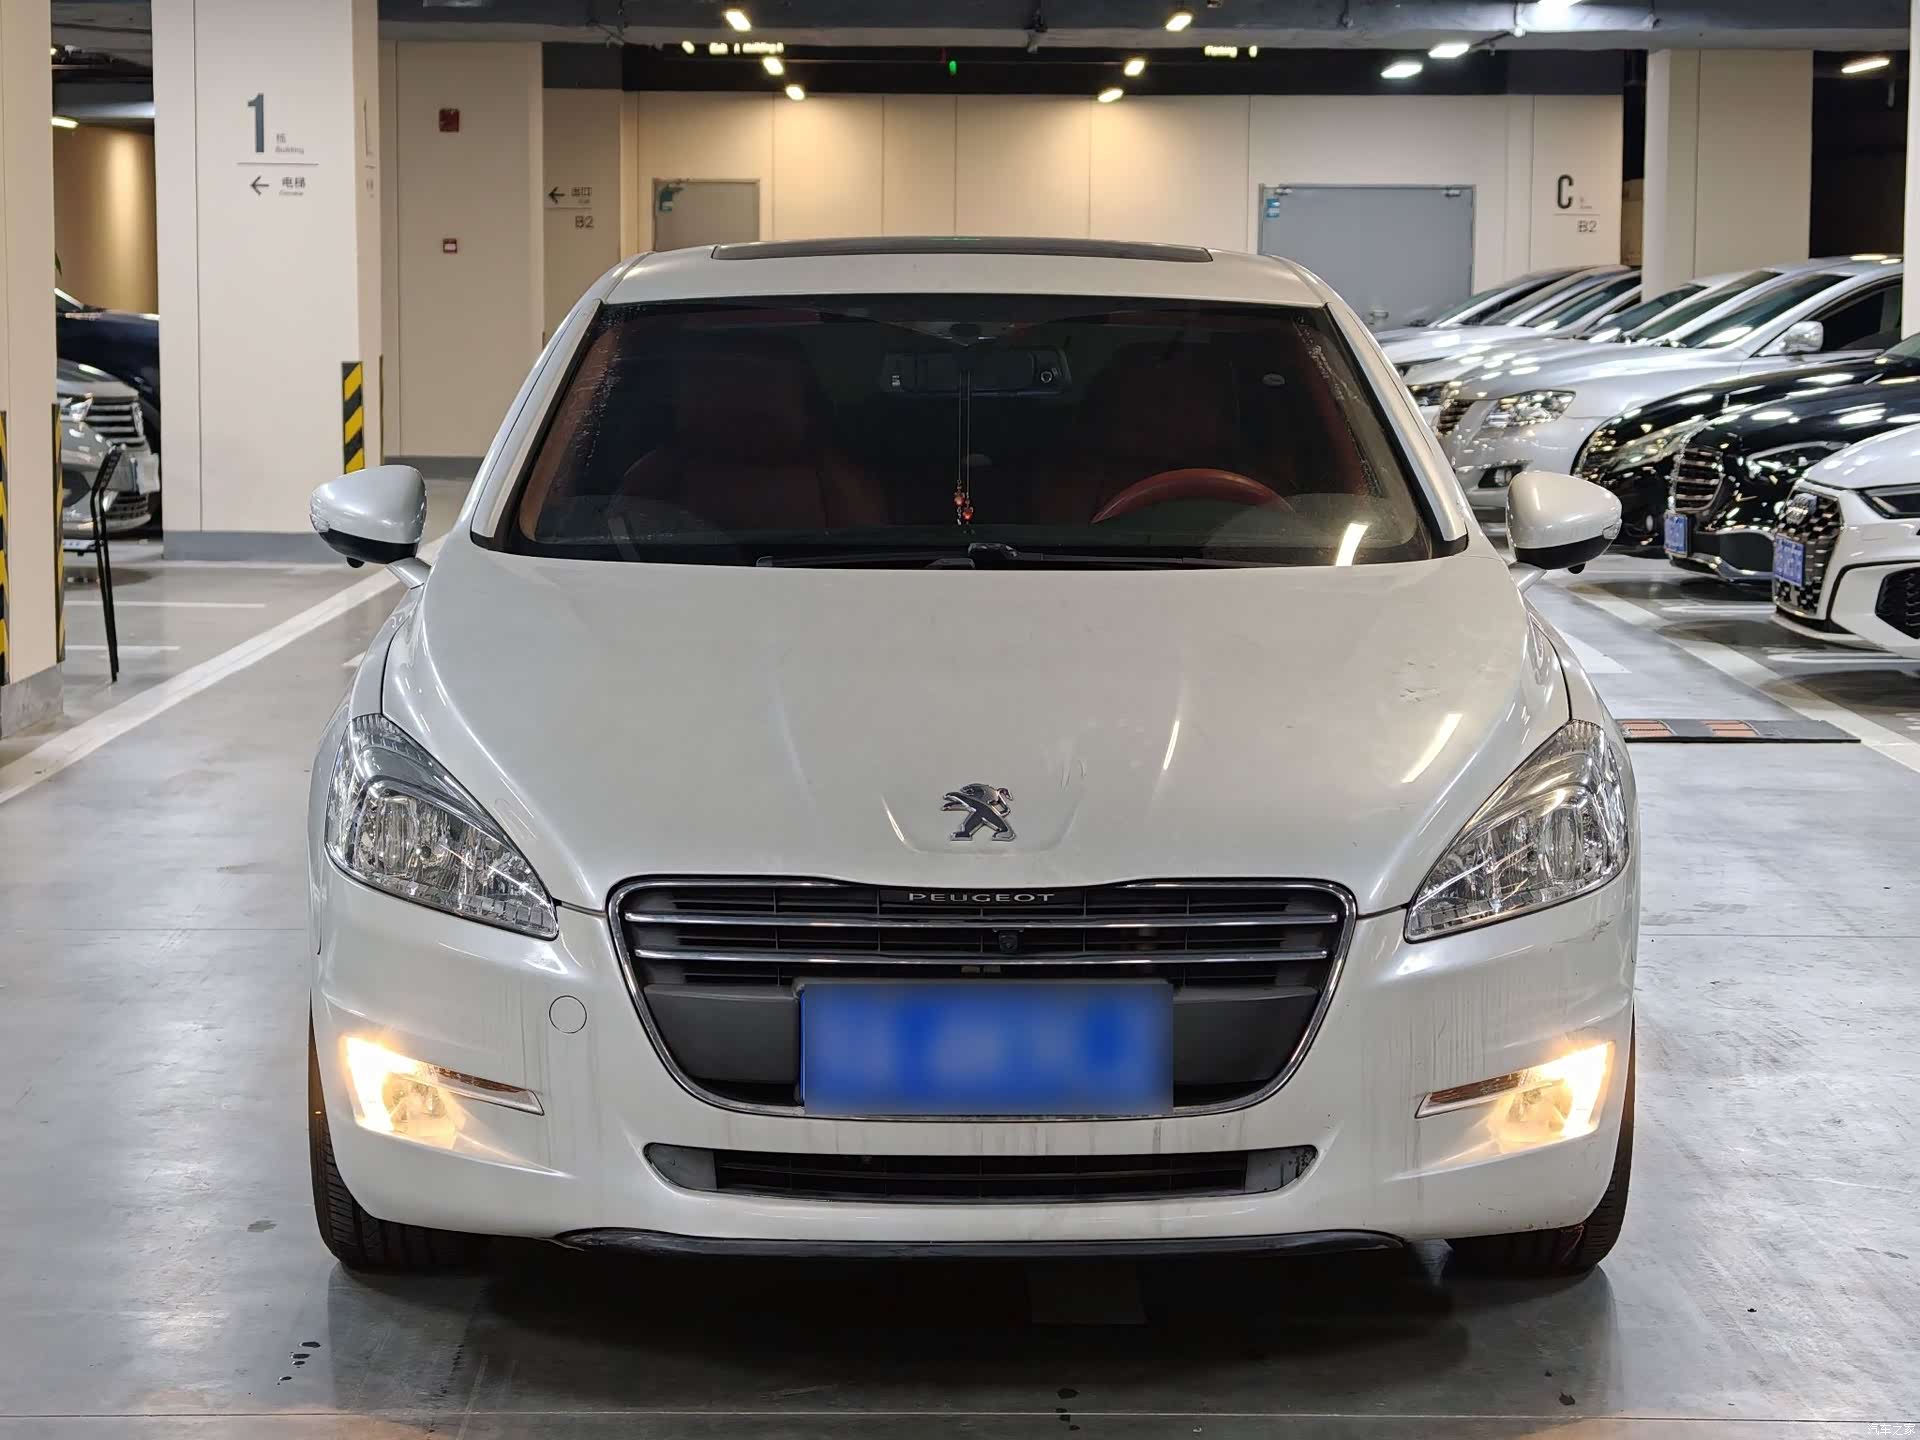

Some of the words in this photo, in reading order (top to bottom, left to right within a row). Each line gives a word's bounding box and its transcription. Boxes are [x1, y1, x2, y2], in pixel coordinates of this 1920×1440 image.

[247, 93, 265, 153] 1
[1557, 174, 1574, 210] C
[575, 215, 595, 228] B2
[1578, 220, 1598, 233] B2
[908, 892, 1055, 902] PEUGEOT
